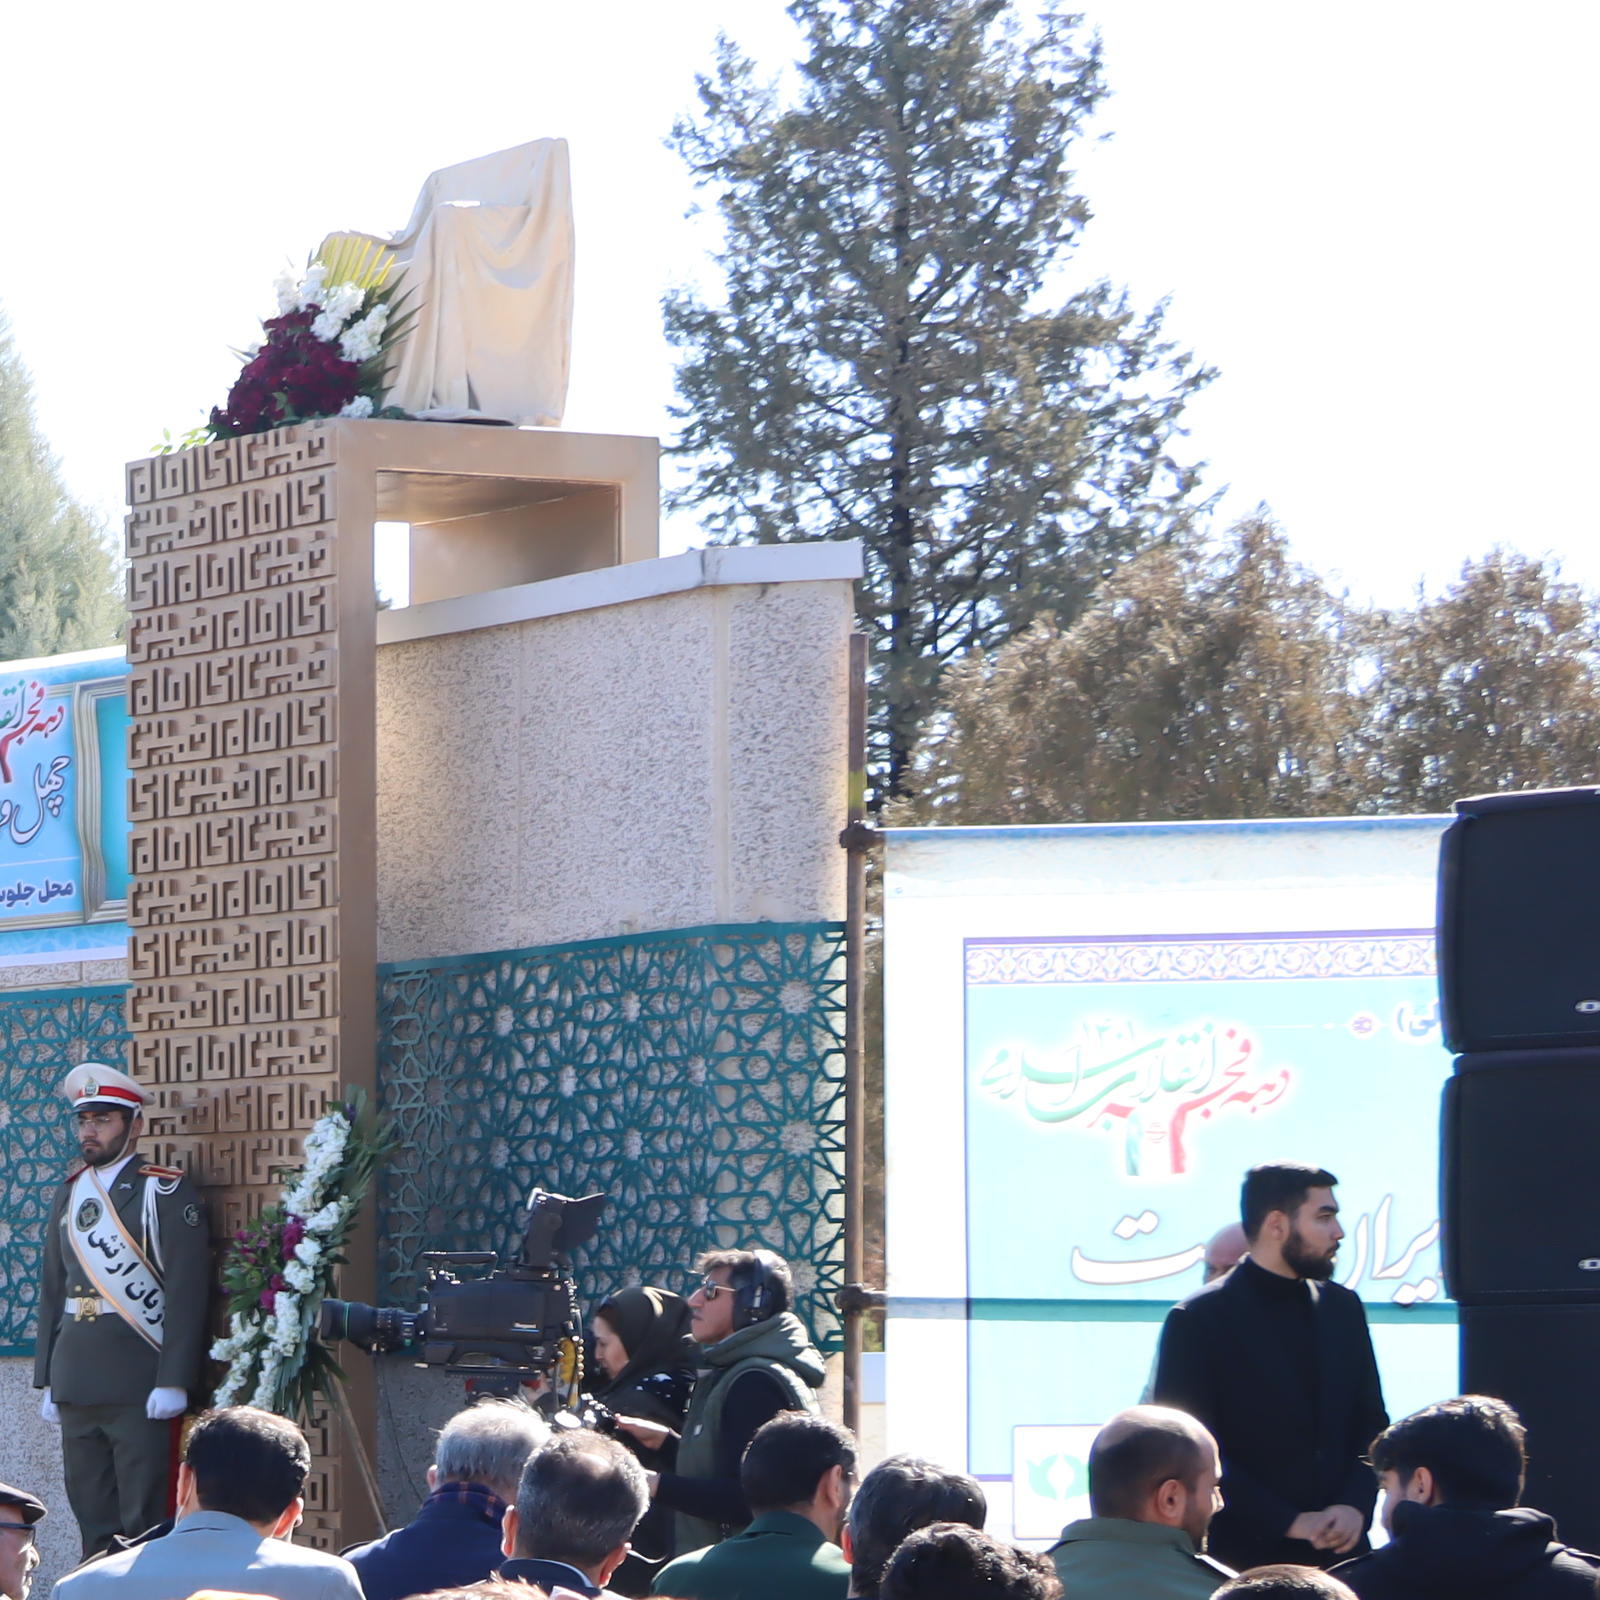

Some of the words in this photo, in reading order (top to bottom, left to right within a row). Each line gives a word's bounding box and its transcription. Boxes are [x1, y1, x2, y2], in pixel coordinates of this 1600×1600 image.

[30, 704, 65, 738] دهه
[9, 755, 72, 844] چهل
[38, 877, 75, 903] محل
[980, 1034, 1164, 1107] اسلامی
[1024, 1020, 1217, 1132] انقلاب
[1221, 1068, 1291, 1115] دهه
[88, 1229, 140, 1276] ارتش
